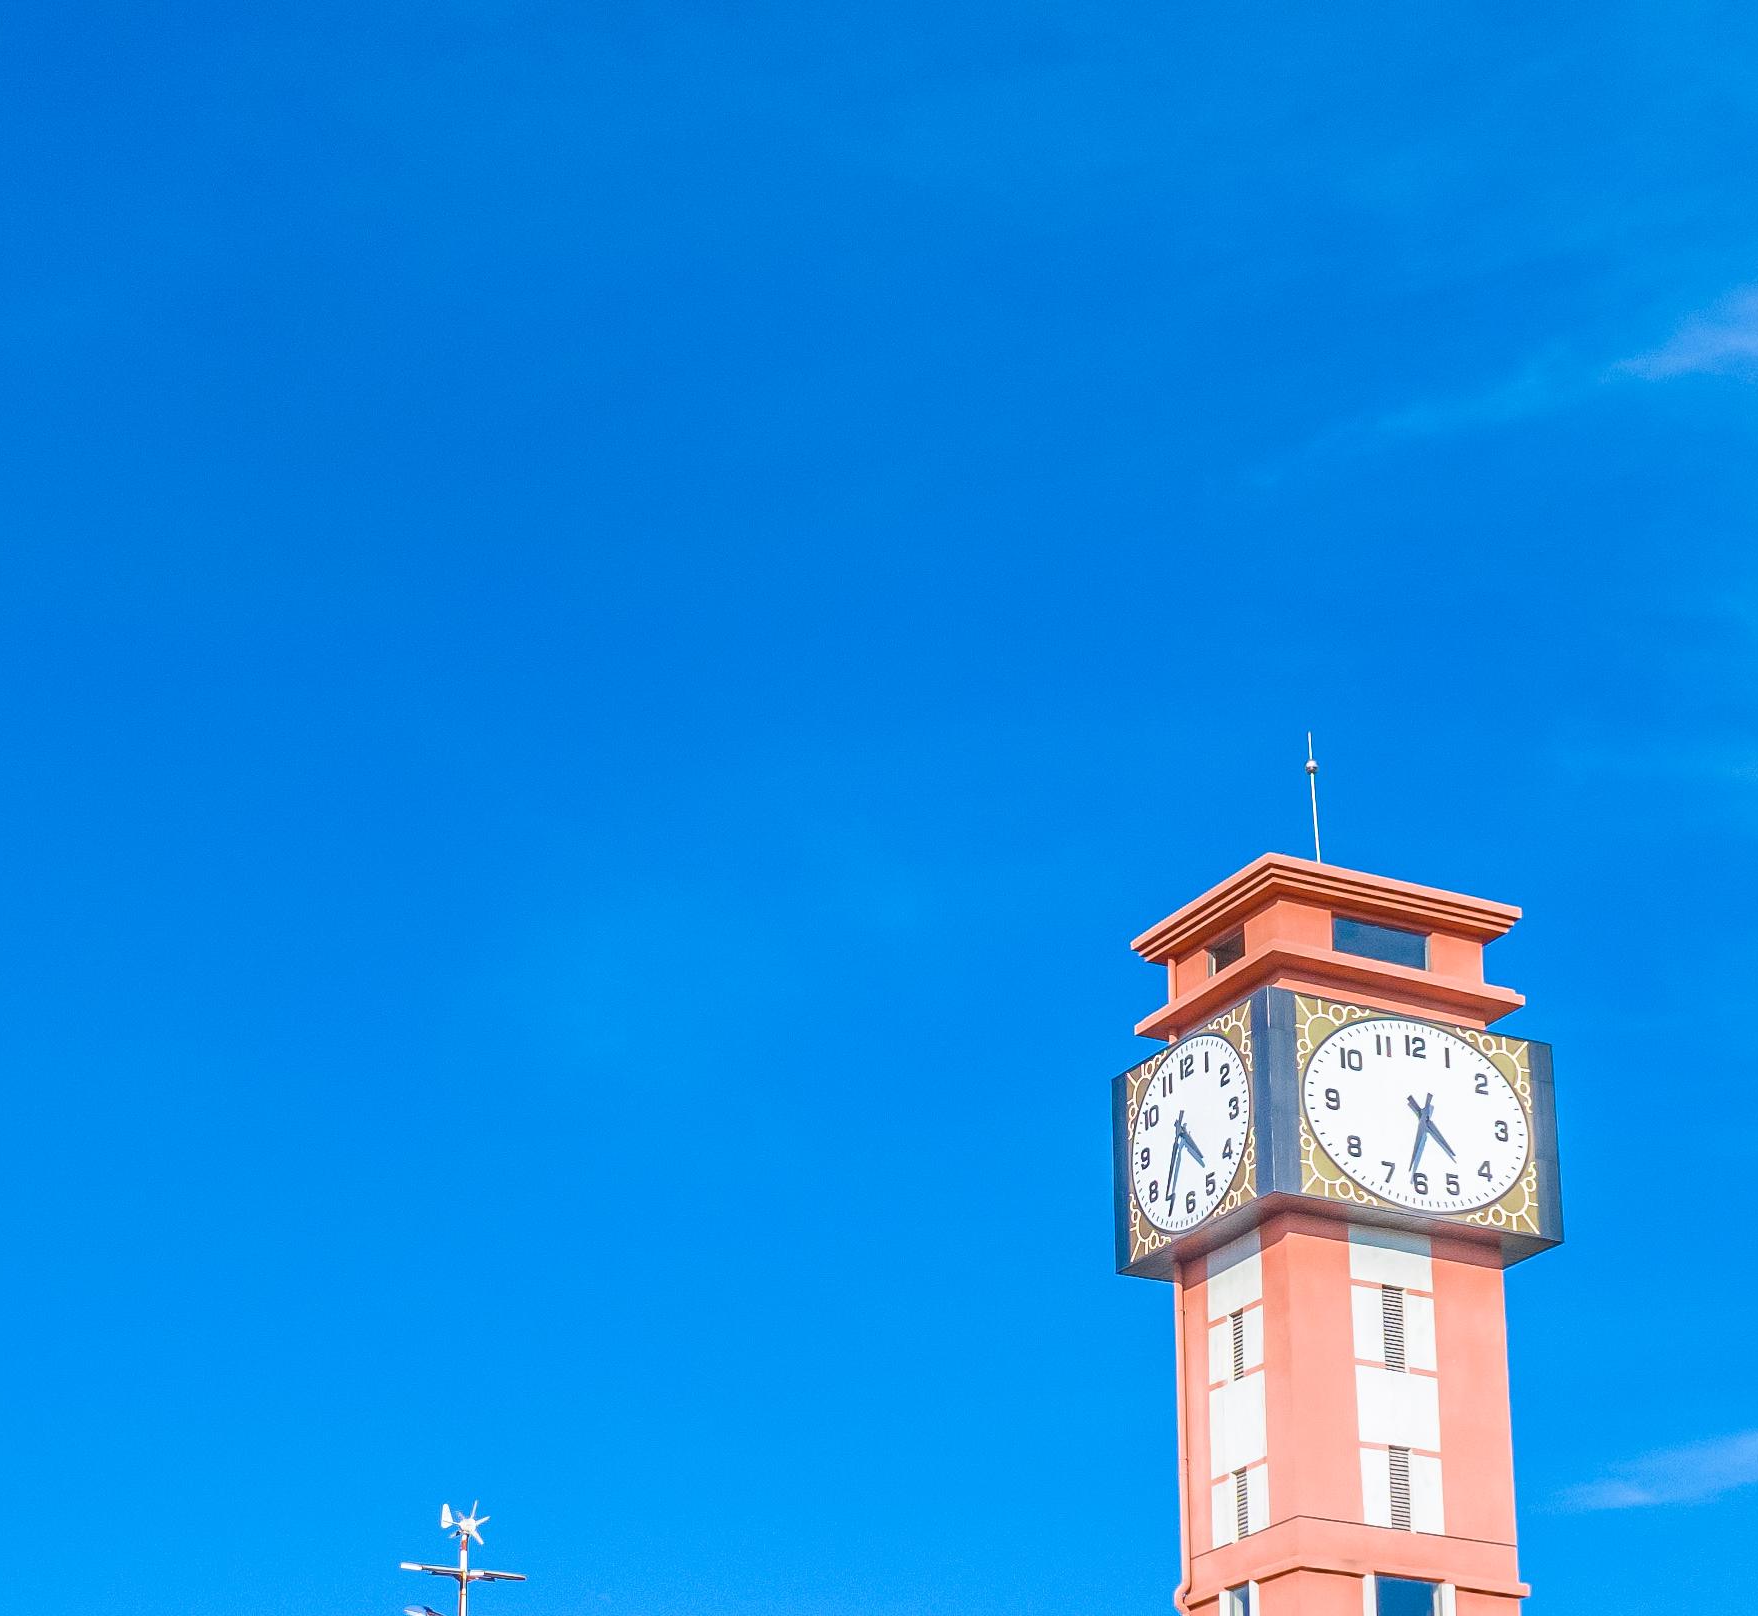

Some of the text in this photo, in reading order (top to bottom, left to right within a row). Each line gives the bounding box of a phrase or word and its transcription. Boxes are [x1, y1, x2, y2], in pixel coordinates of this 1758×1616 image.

[1375, 1033, 1392, 1058] 11
[1405, 1034, 1427, 1059] 12
[1179, 1054, 1194, 1081] 12
[1204, 1051, 1210, 1074] 1
[1339, 1047, 1364, 1072] 10
[1444, 1047, 1451, 1069] 1
[1162, 1072, 1174, 1098] 11
[1219, 1063, 1231, 1088] 2
[1474, 1073, 1490, 1096] 2
[1228, 1096, 1240, 1121] 3
[1324, 1088, 1341, 1111] 9
[1144, 1105, 1160, 1132] 10
[1494, 1120, 1510, 1143] 3
[1222, 1137, 1233, 1160] 4
[1346, 1135, 1363, 1158] 8
[1140, 1147, 1151, 1171] 9
[1381, 1160, 1396, 1184] 7
[1477, 1160, 1494, 1183] 4
[1148, 1180, 1160, 1204] 8
[1205, 1171, 1217, 1197] 5
[1413, 1172, 1429, 1196] 6
[1445, 1173, 1461, 1196] 5
[1185, 1190, 1197, 1215] 6
